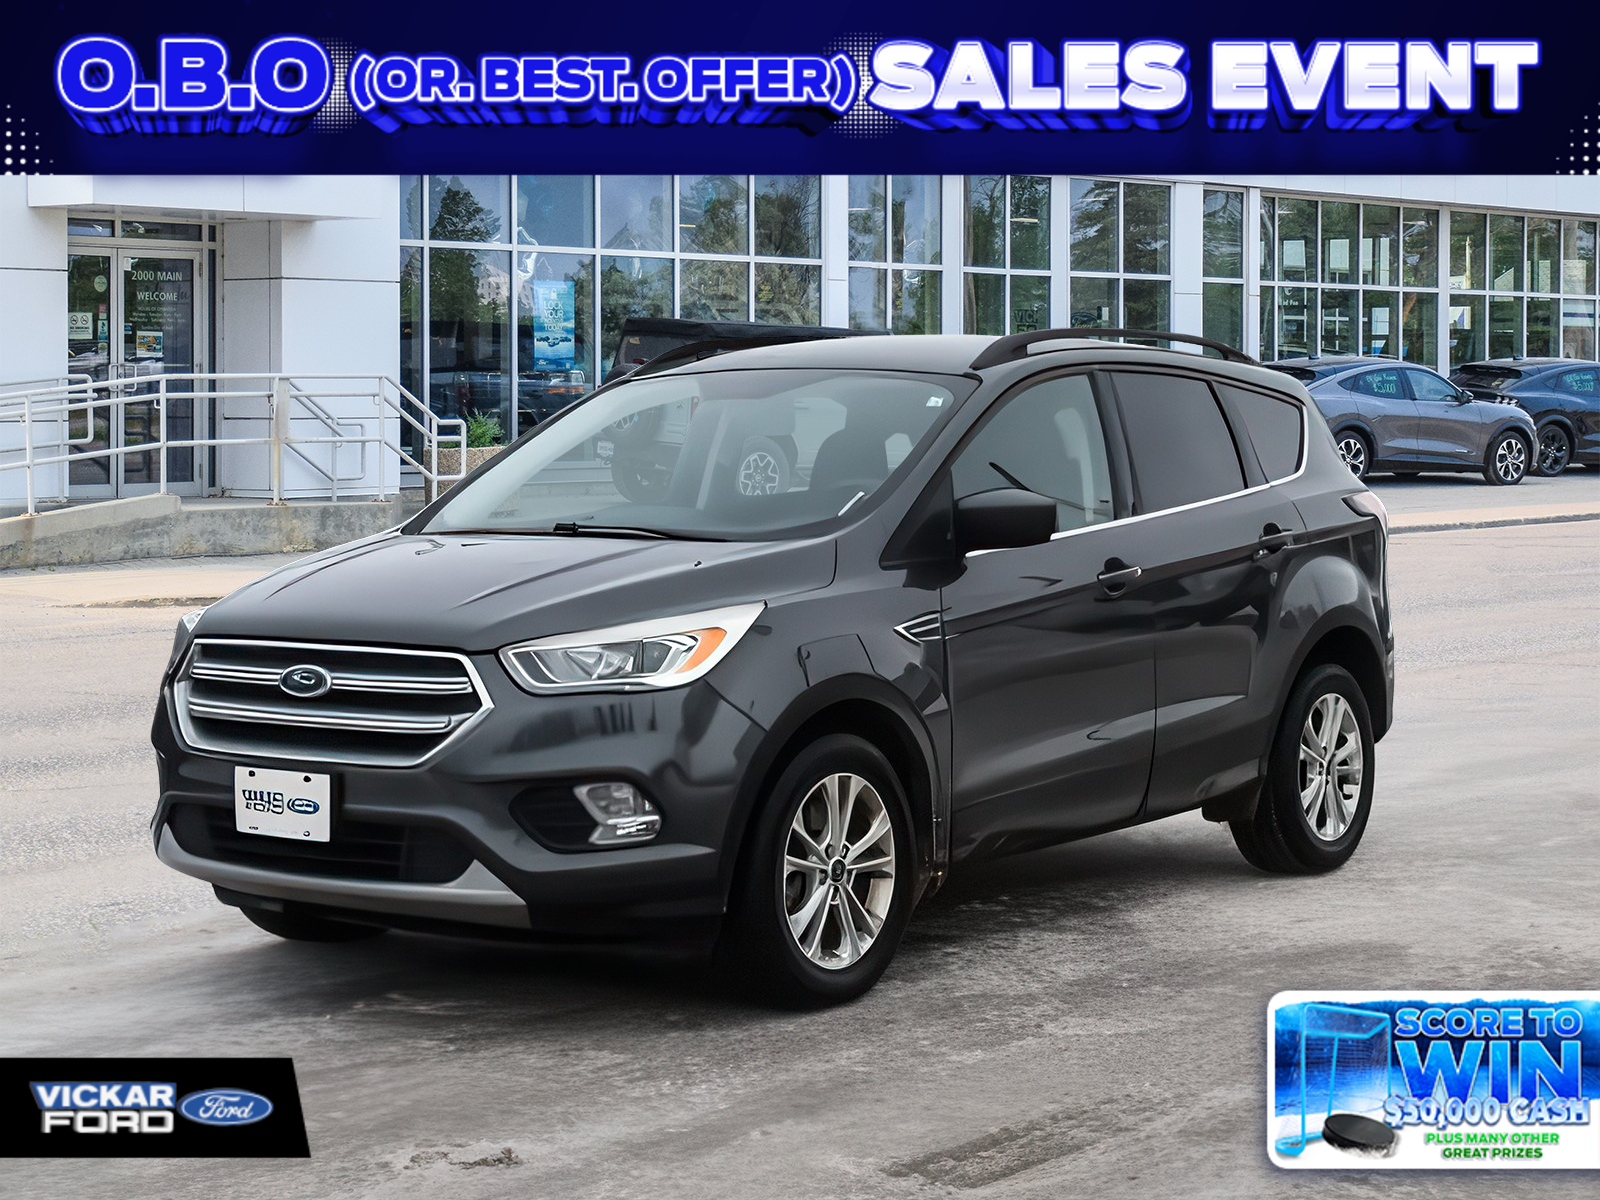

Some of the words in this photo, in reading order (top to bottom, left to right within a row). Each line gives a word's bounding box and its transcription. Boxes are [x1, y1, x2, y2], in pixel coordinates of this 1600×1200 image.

[131, 270, 155, 281] 2000
[157, 271, 183, 281] MAIN
[136, 291, 178, 301] WELCOME
[543, 309, 564, 318] YOUR
